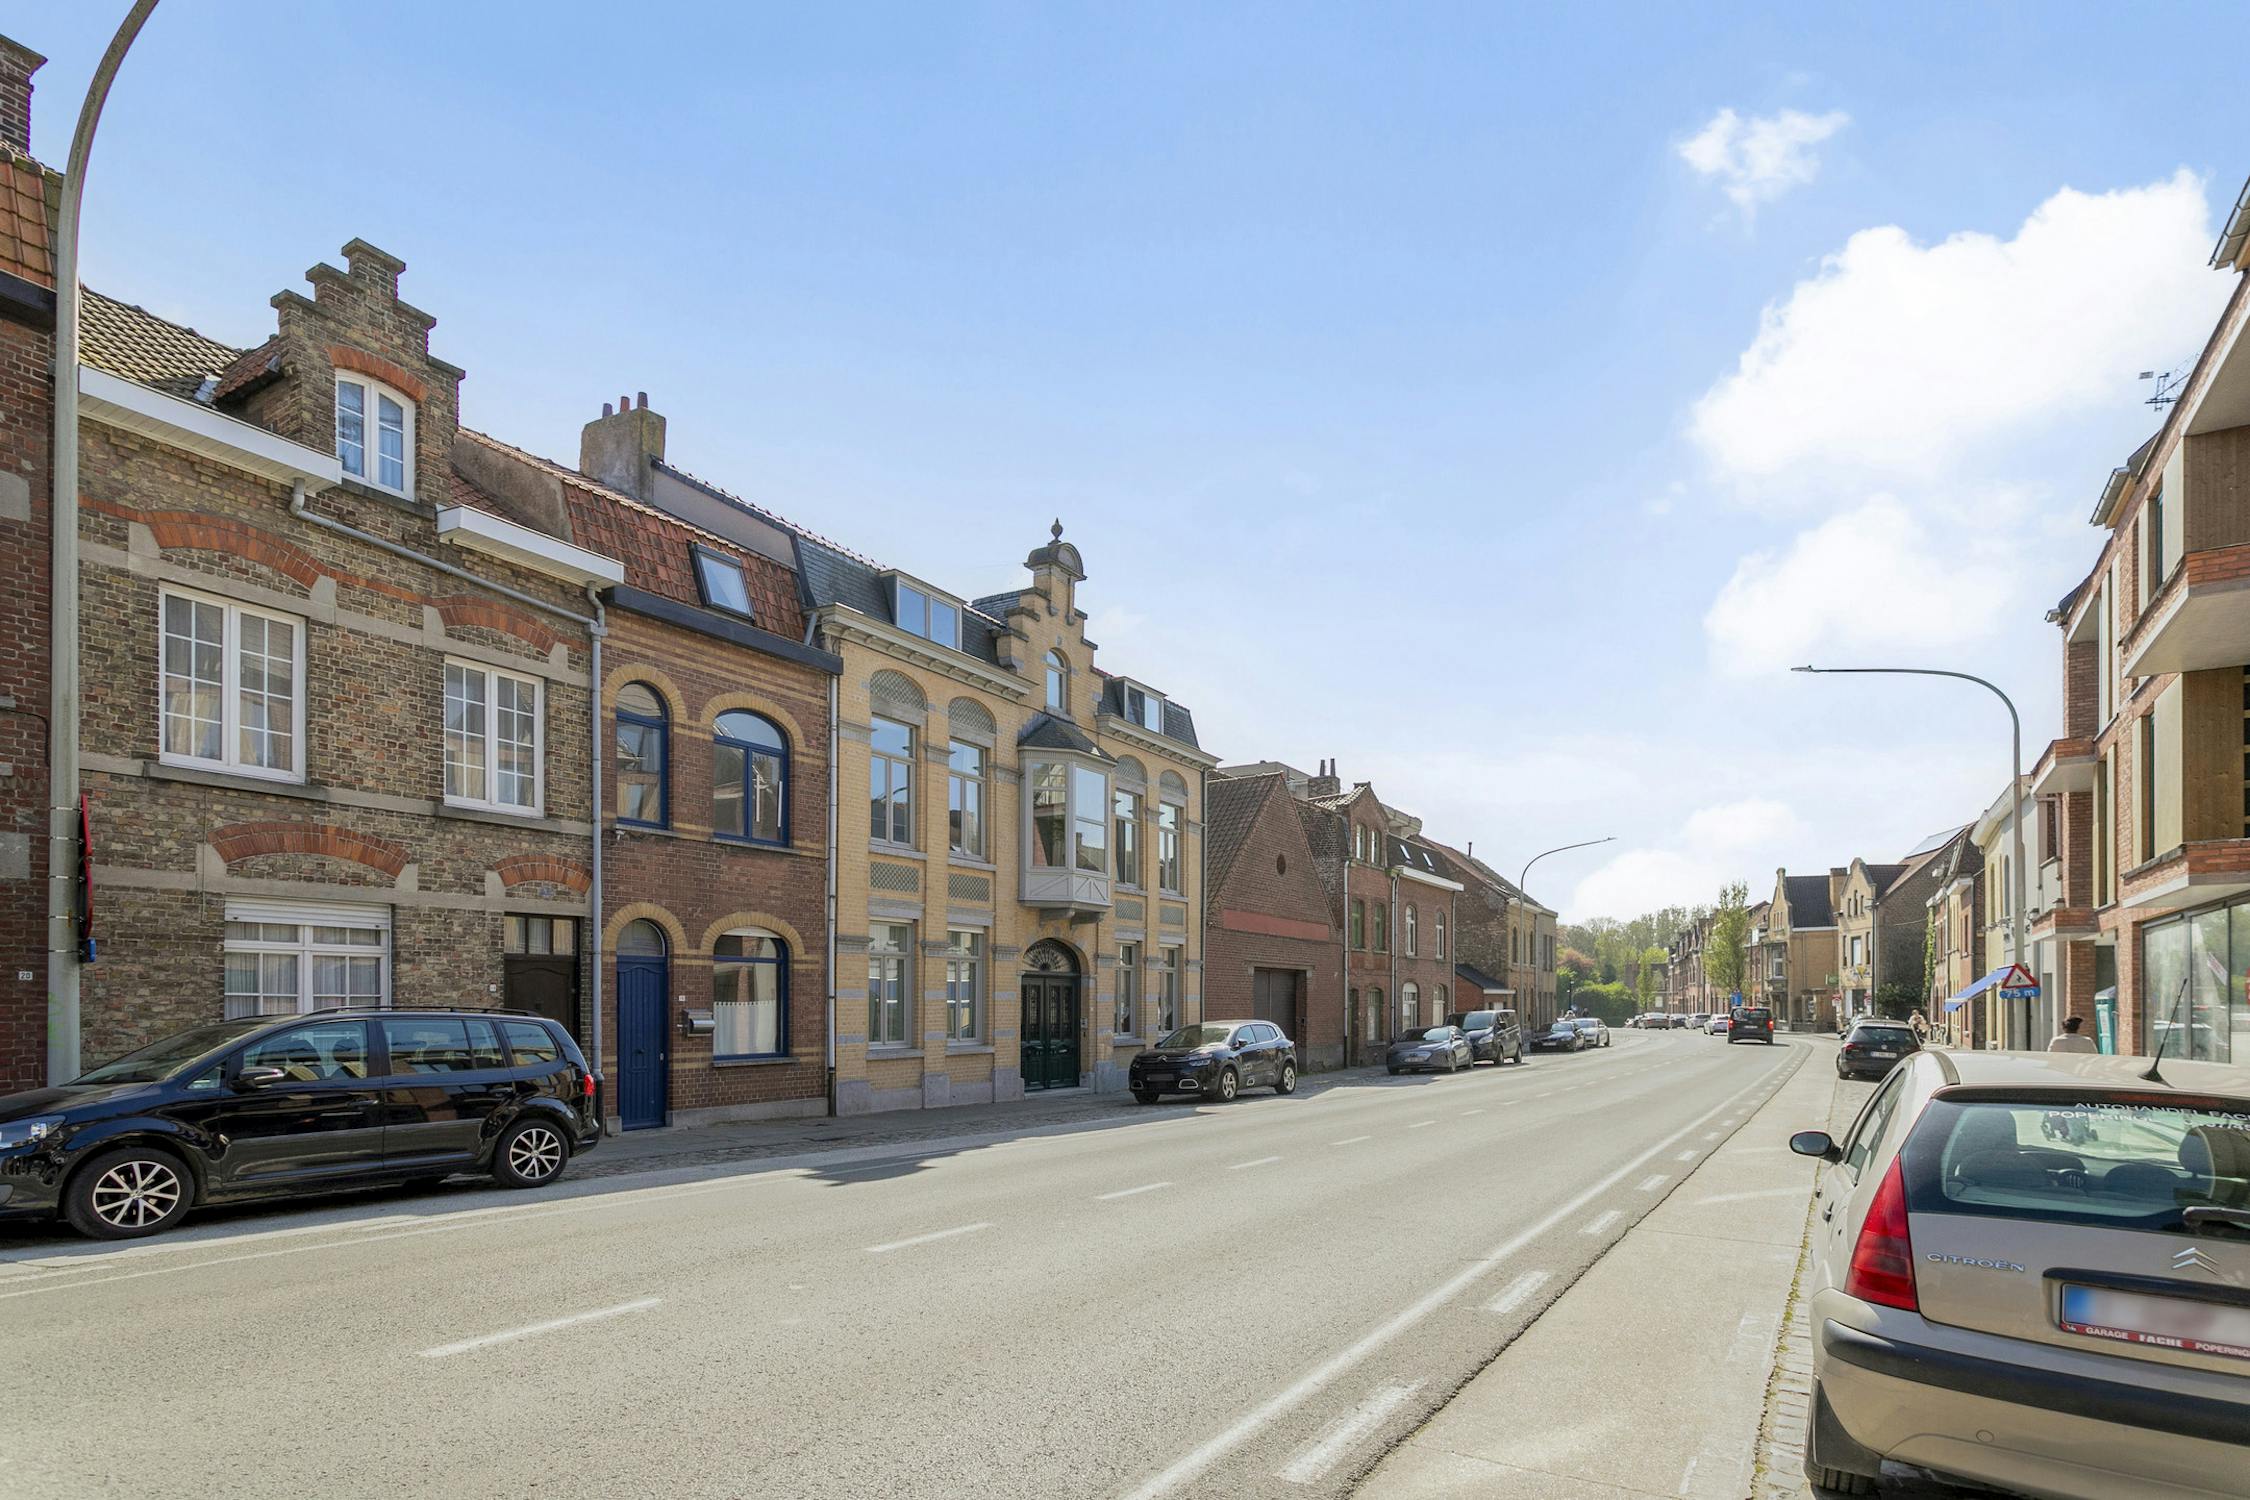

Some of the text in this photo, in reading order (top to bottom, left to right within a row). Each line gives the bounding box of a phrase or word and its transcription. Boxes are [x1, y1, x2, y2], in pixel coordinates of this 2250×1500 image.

[2006, 990, 2021, 998] 75
[2075, 1103, 2198, 1116] AUTOHANDEL
[1926, 1252, 2024, 1272] CITROËN
[2085, 1326, 2128, 1339] GARAGE
